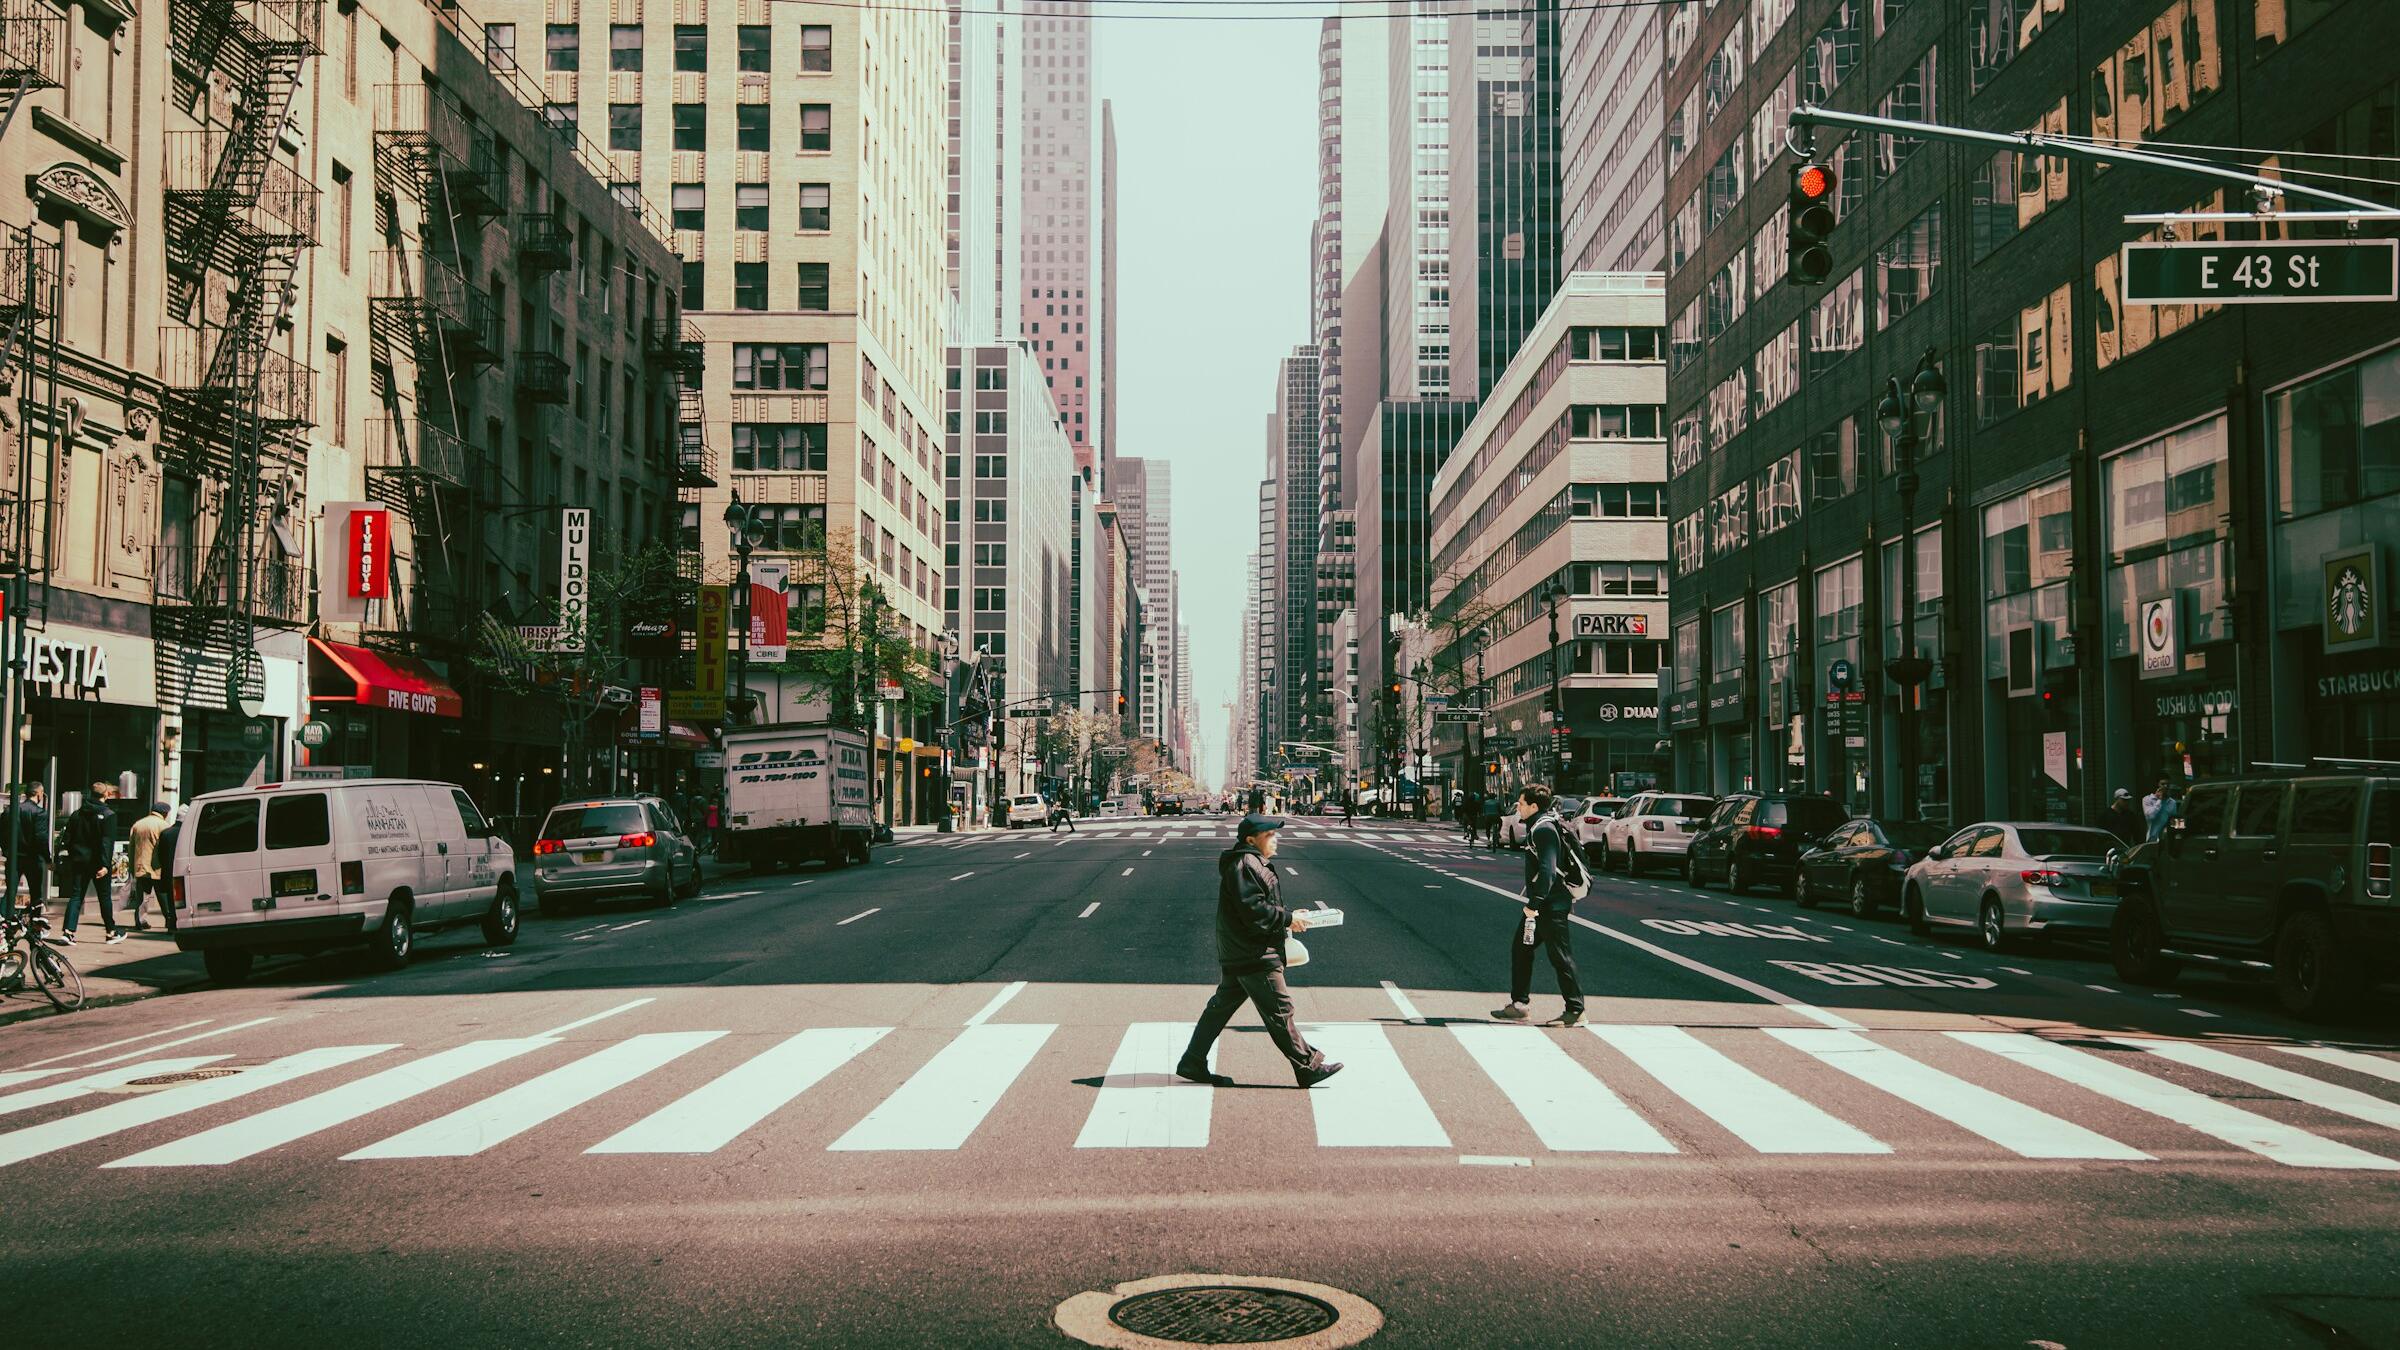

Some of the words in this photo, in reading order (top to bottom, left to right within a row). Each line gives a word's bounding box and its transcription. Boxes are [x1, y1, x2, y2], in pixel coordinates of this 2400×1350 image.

[2202, 256, 2218, 289] E
[2233, 255, 2272, 289] 43
[2288, 255, 2320, 288] St
[362, 515, 373, 553] FIVE
[361, 554, 372, 592] GUYS
[522, 627, 558, 638] IRISH
[1580, 615, 1629, 634] PARK
[702, 591, 722, 691] DELI
[2147, 655, 2171, 669] bento
[388, 689, 409, 710] FIVE
[411, 692, 437, 713] GUYS
[2157, 695, 2187, 716] SUSHI
[2189, 694, 2196, 713] &
[304, 725, 323, 735] NAYA
[1640, 918, 1832, 943] ONLY
[1766, 960, 1998, 989] BUS
